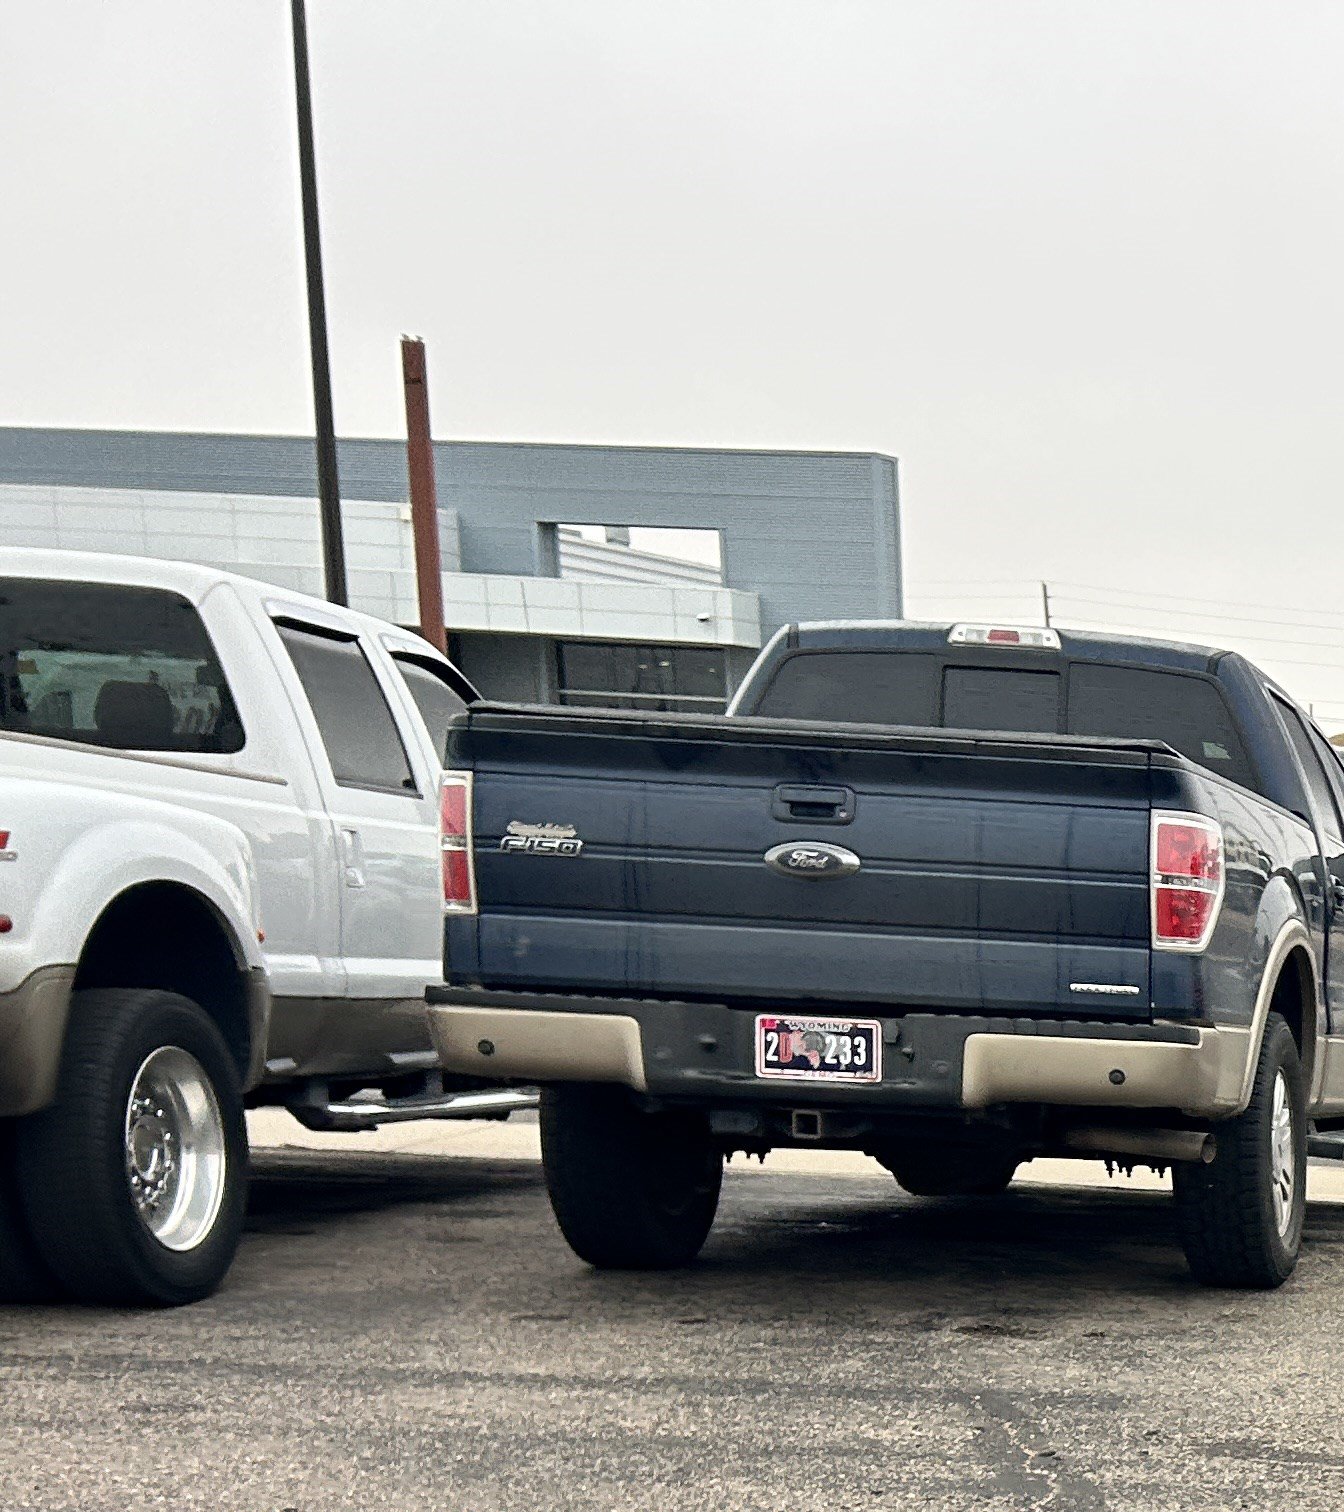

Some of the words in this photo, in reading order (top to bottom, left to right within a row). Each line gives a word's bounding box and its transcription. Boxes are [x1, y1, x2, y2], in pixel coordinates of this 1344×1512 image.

[788, 850, 829, 868] Ford
[787, 1019, 853, 1032] WYOMING
[824, 1034, 867, 1066] 233
